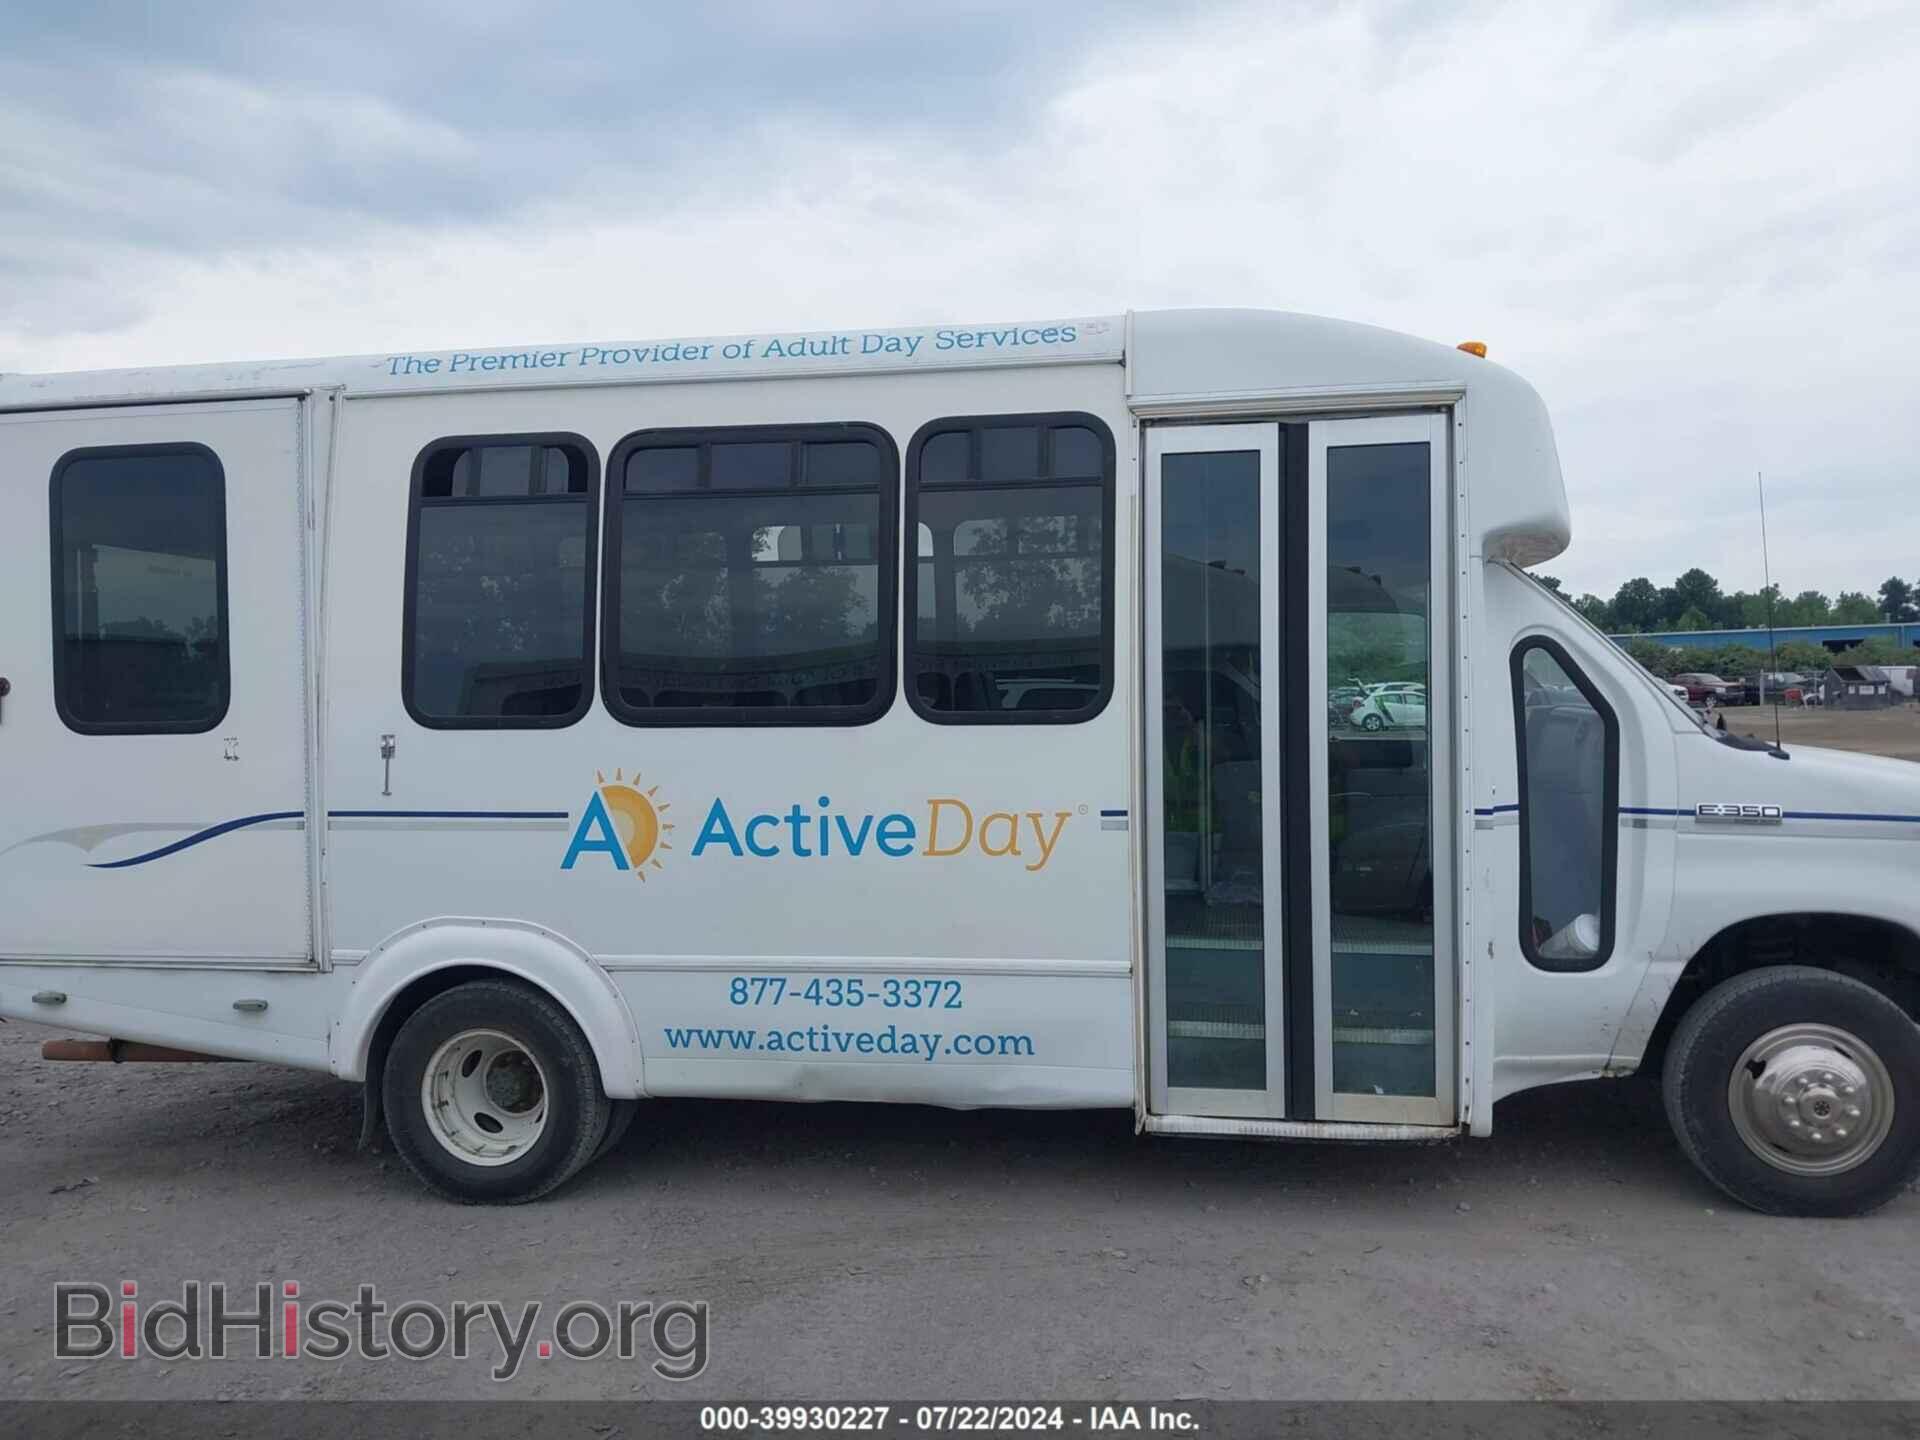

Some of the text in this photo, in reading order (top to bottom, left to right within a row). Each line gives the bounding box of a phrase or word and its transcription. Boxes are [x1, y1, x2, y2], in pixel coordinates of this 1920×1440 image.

[387, 325, 1077, 376] The Premier Provider of Adult Day Services
[729, 976, 963, 1009] 877-435-3372
[664, 1024, 1035, 1062] www.activeday.com
